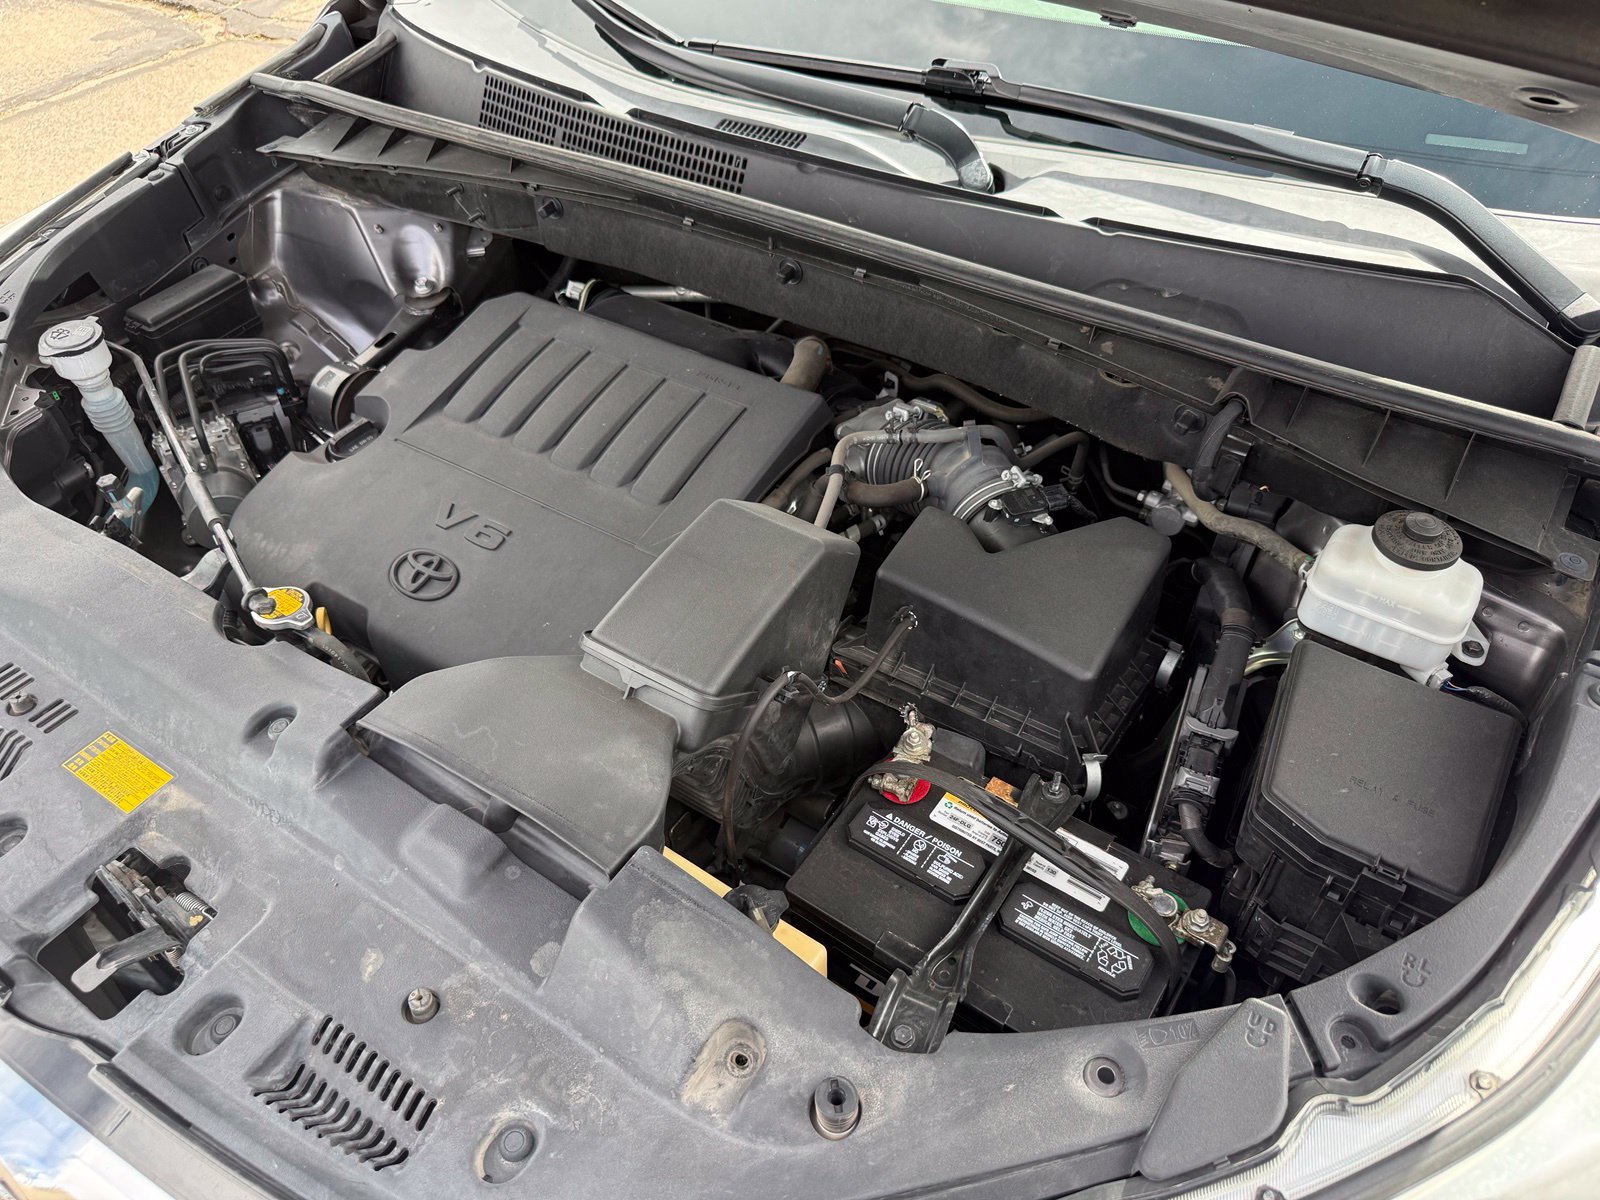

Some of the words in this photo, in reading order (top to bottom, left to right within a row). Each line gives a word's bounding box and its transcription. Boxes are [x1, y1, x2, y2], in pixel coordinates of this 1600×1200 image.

[435, 502, 513, 551] V6
[892, 816, 925, 837] DANGER
[931, 837, 962, 857] POISON
